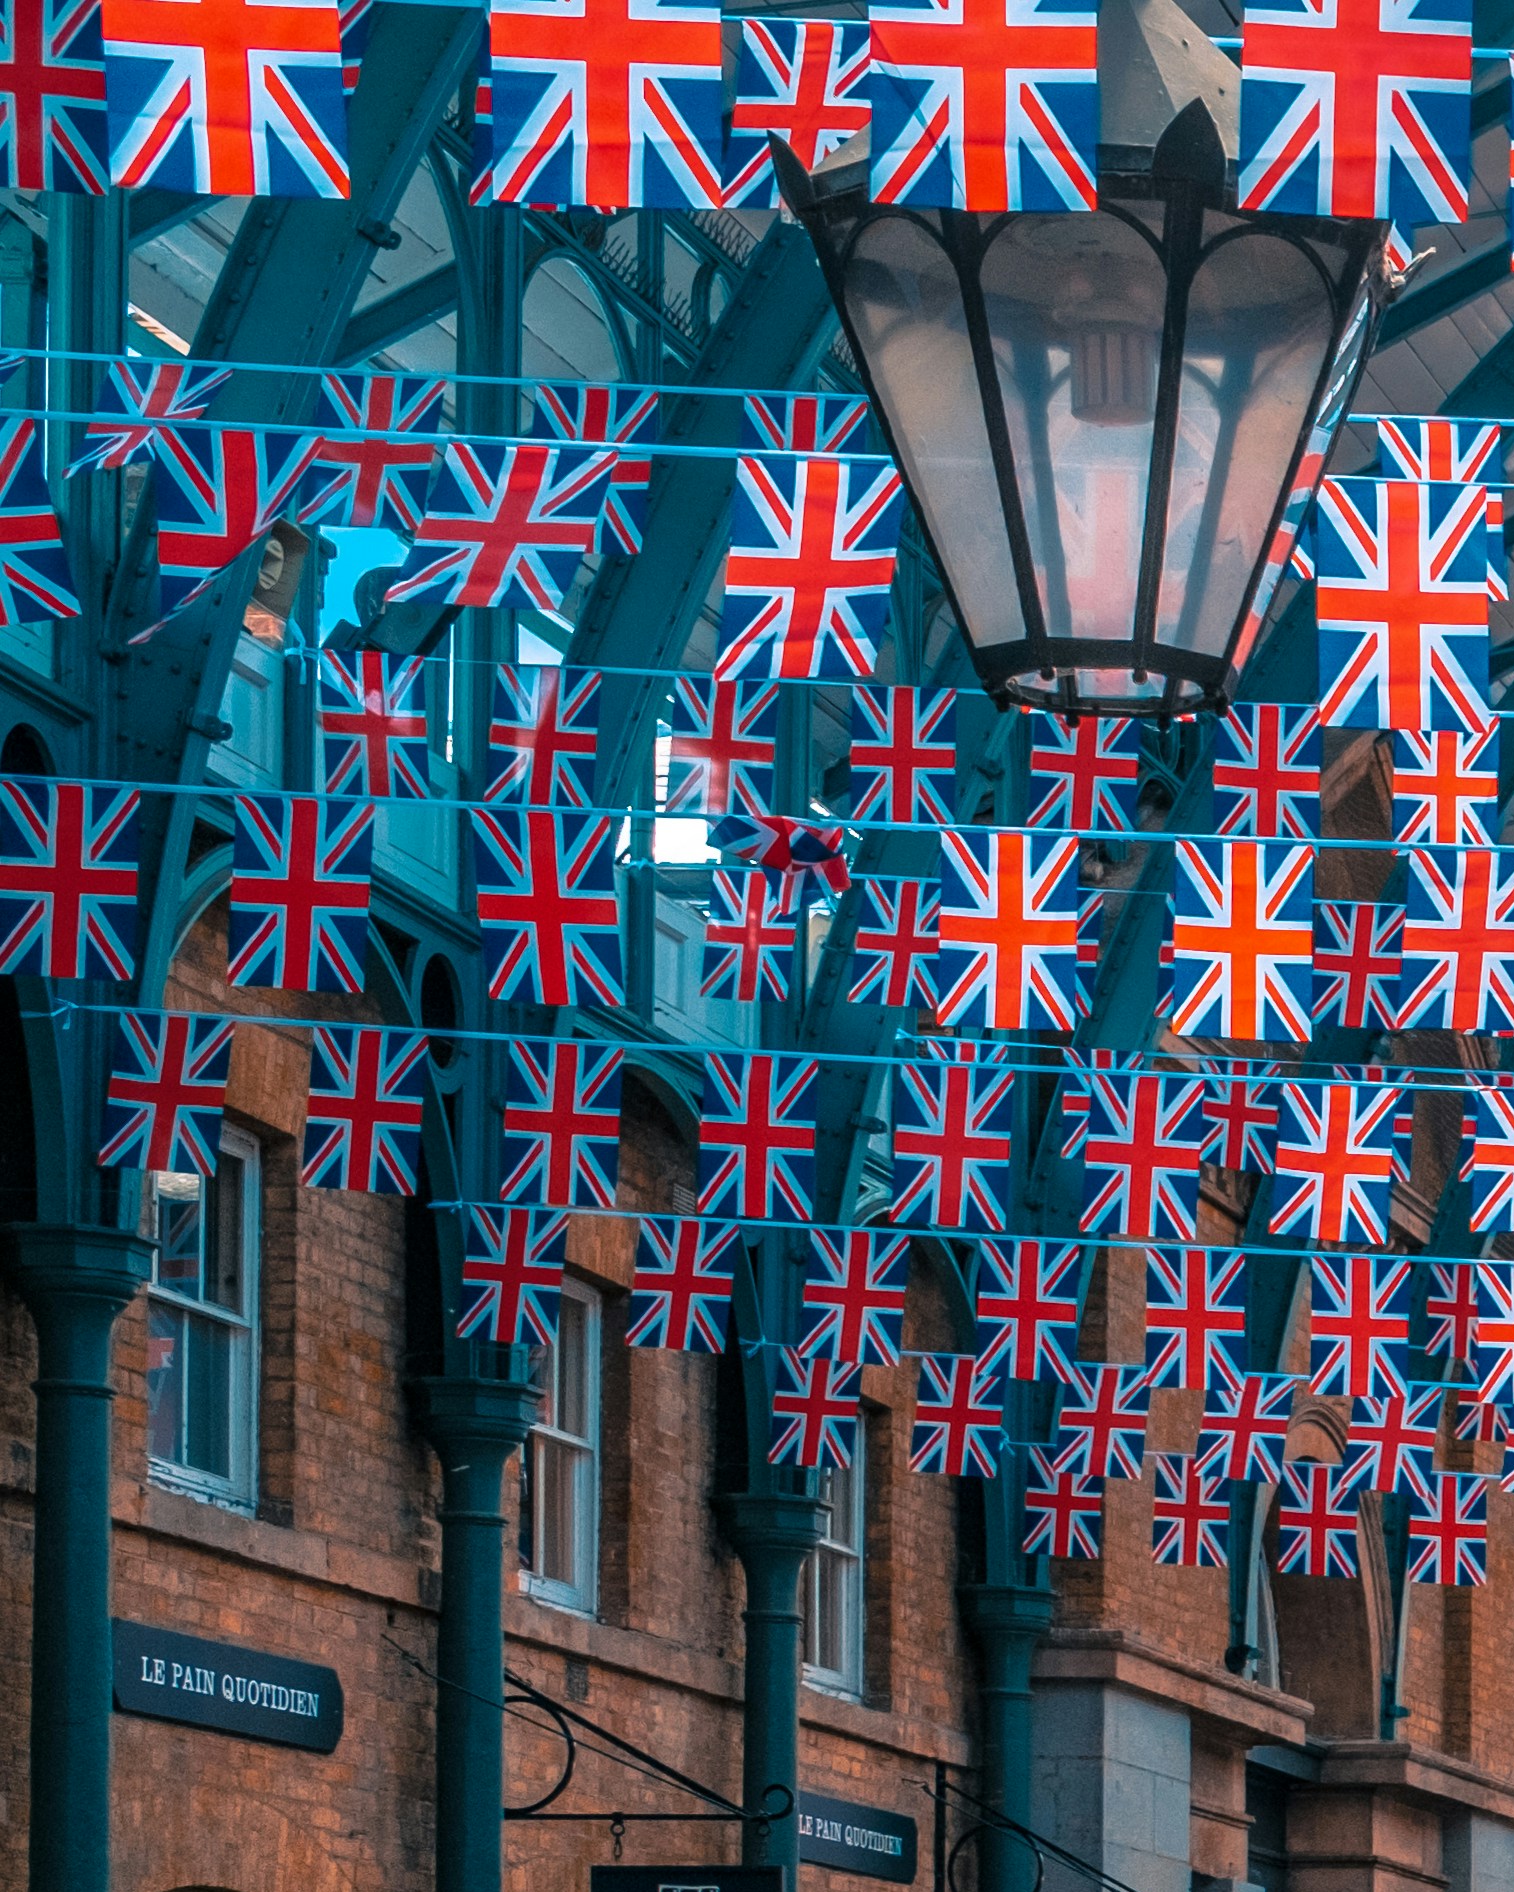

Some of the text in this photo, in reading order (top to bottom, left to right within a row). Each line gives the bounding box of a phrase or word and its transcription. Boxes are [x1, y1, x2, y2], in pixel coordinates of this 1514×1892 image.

[141, 1656, 320, 1718] LE PAIN QUOTIDIEN
[799, 1813, 903, 1856] LE PAIN QUOTIDIEN
